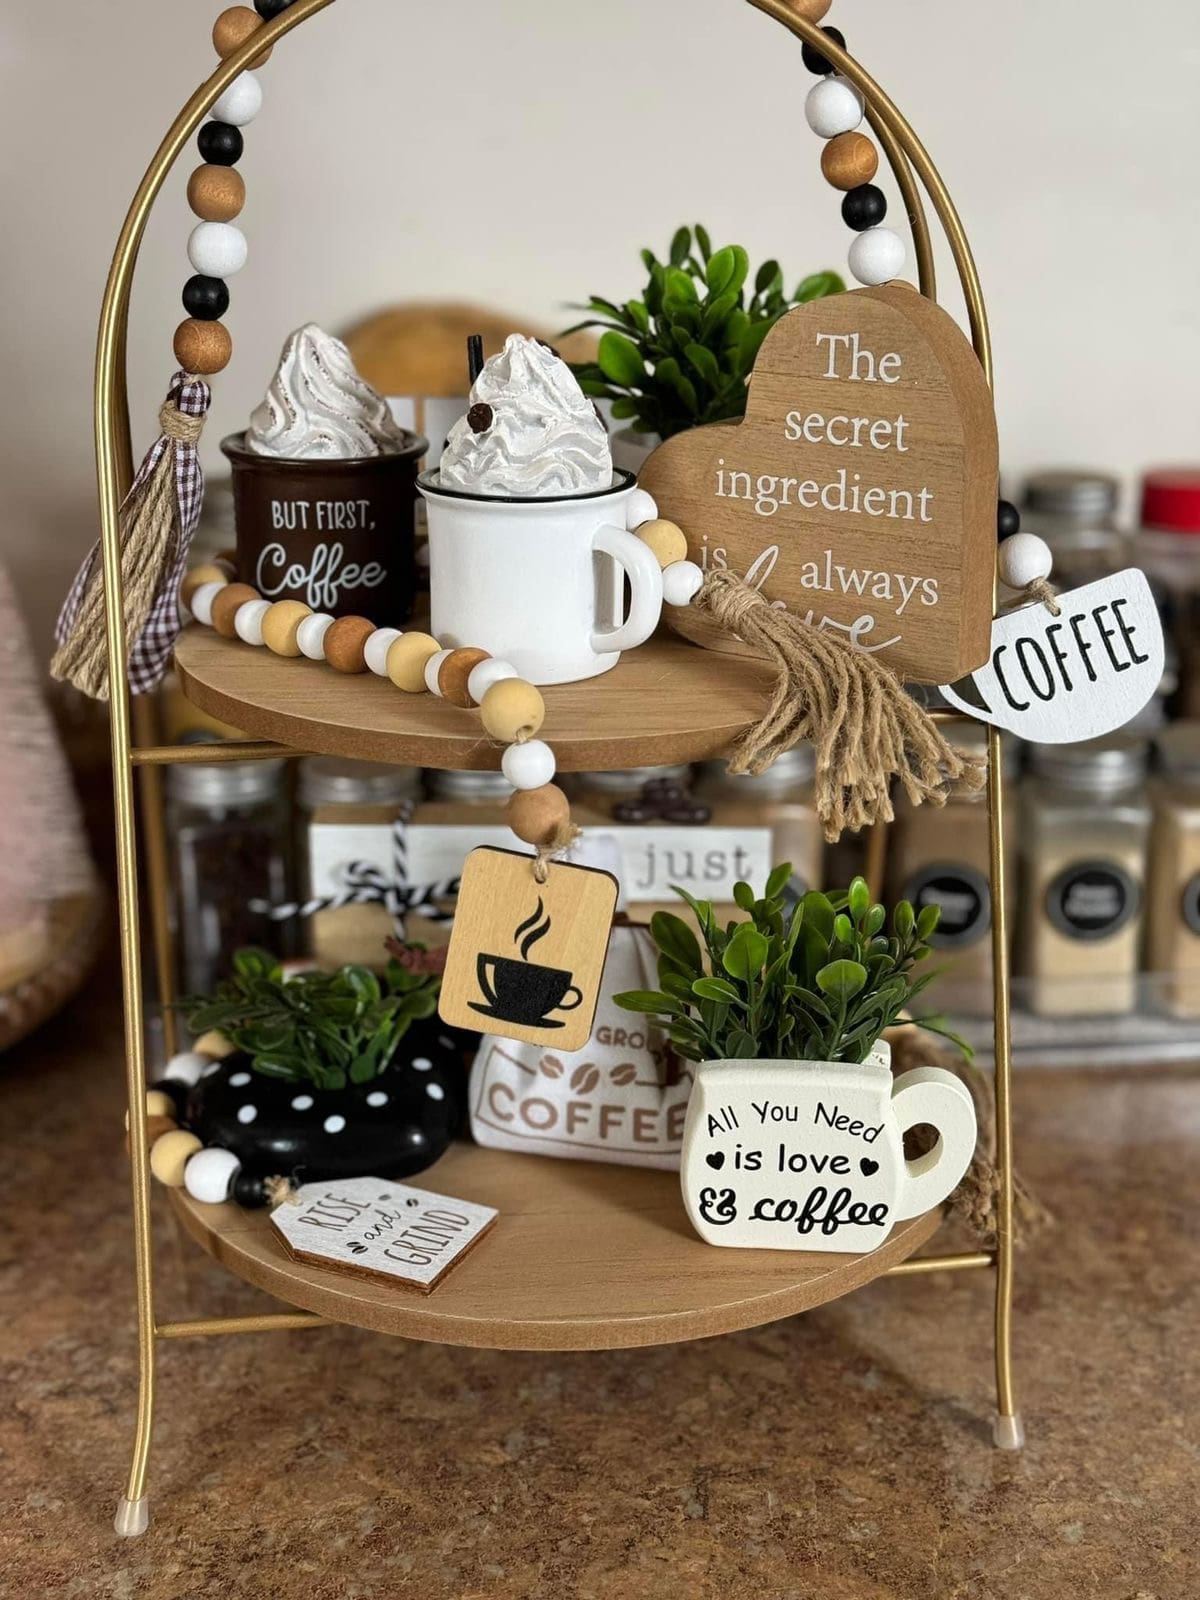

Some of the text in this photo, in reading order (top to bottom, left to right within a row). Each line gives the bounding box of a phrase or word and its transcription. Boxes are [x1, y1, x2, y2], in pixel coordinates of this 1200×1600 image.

[816, 333, 901, 384] The
[785, 410, 909, 452] secret
[715, 458, 934, 522] ingredient
[272, 500, 376, 530] BUT FIRST,
[256, 543, 388, 609] Coffee
[700, 534, 728, 571] is
[800, 550, 939, 616] always
[993, 599, 1149, 711] COFFEE
[637, 843, 753, 890] just
[596, 1026, 650, 1051] GRO
[489, 1082, 687, 1143] COFFEE
[708, 1101, 885, 1143] All You Need
[735, 1144, 851, 1174] is love
[298, 1193, 372, 1232] RISE
[364, 1209, 401, 1240] and
[699, 1186, 889, 1235] & coffee
[384, 1210, 470, 1265] GRIND
